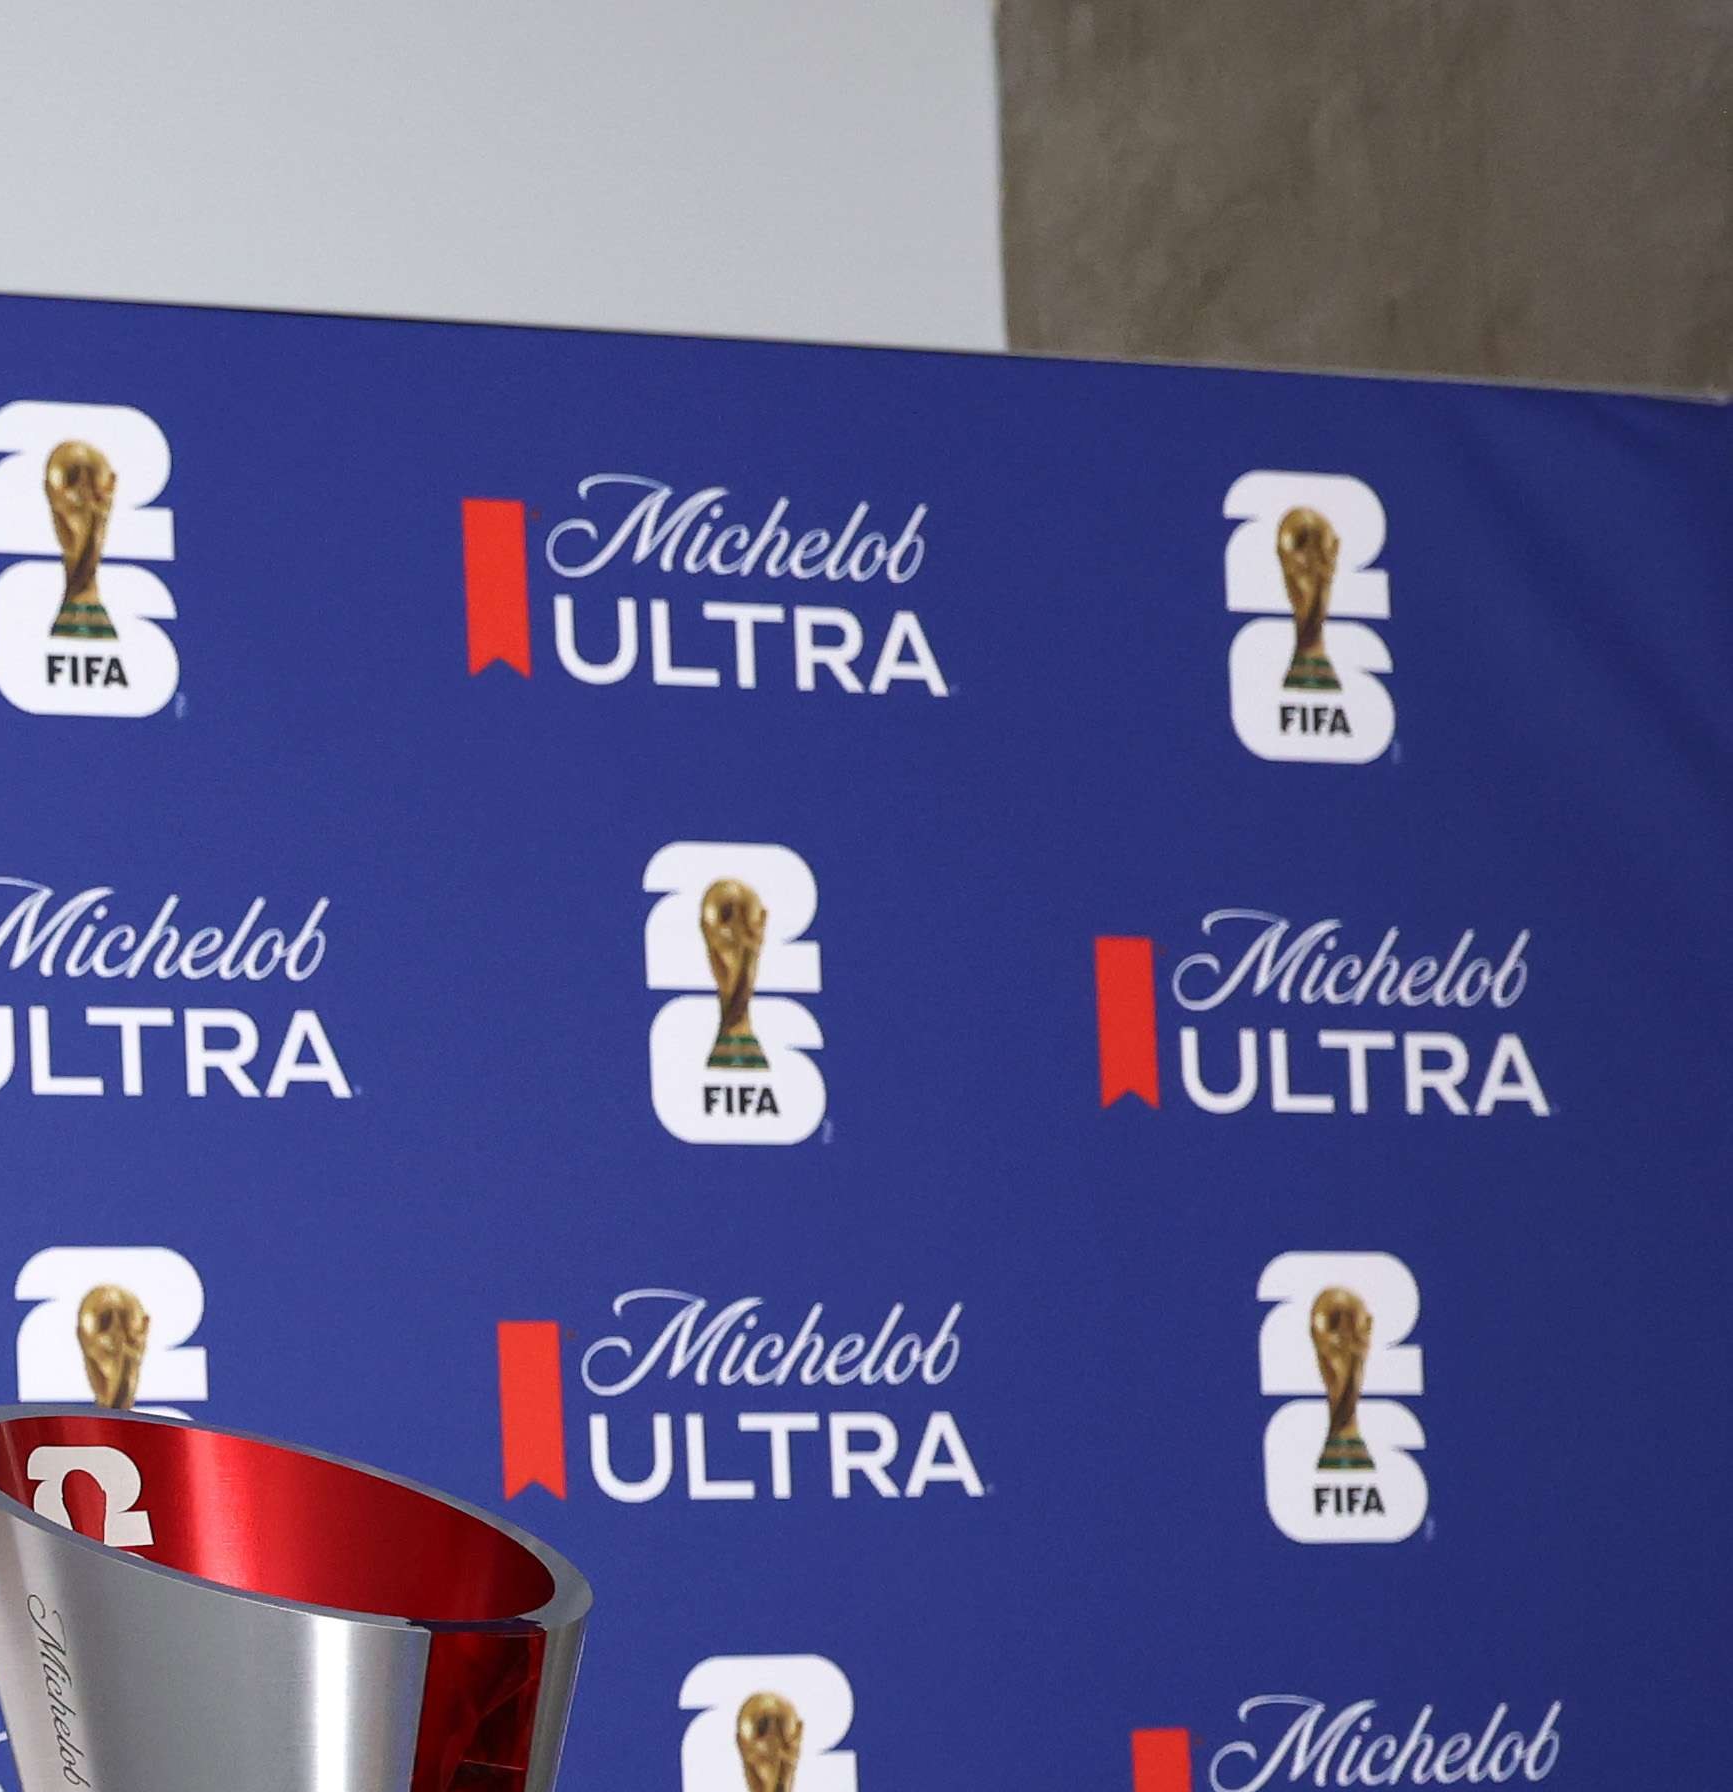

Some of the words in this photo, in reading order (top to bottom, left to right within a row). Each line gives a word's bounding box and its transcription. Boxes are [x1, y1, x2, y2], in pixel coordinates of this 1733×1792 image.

[545, 473, 929, 583] Michelob
[46, 653, 129, 688] FIFA
[553, 594, 949, 698] ULTRA
[1279, 704, 1352, 736] FIFA
[1172, 908, 1531, 1011] Michelob
[703, 1085, 779, 1116] FIFA
[1179, 1026, 1550, 1116] ULTRA
[581, 1288, 963, 1396] Michelob
[588, 1411, 985, 1503] ULTRA
[1313, 1485, 1386, 1515] FIFA
[26, 1592, 92, 1788] Michelob
